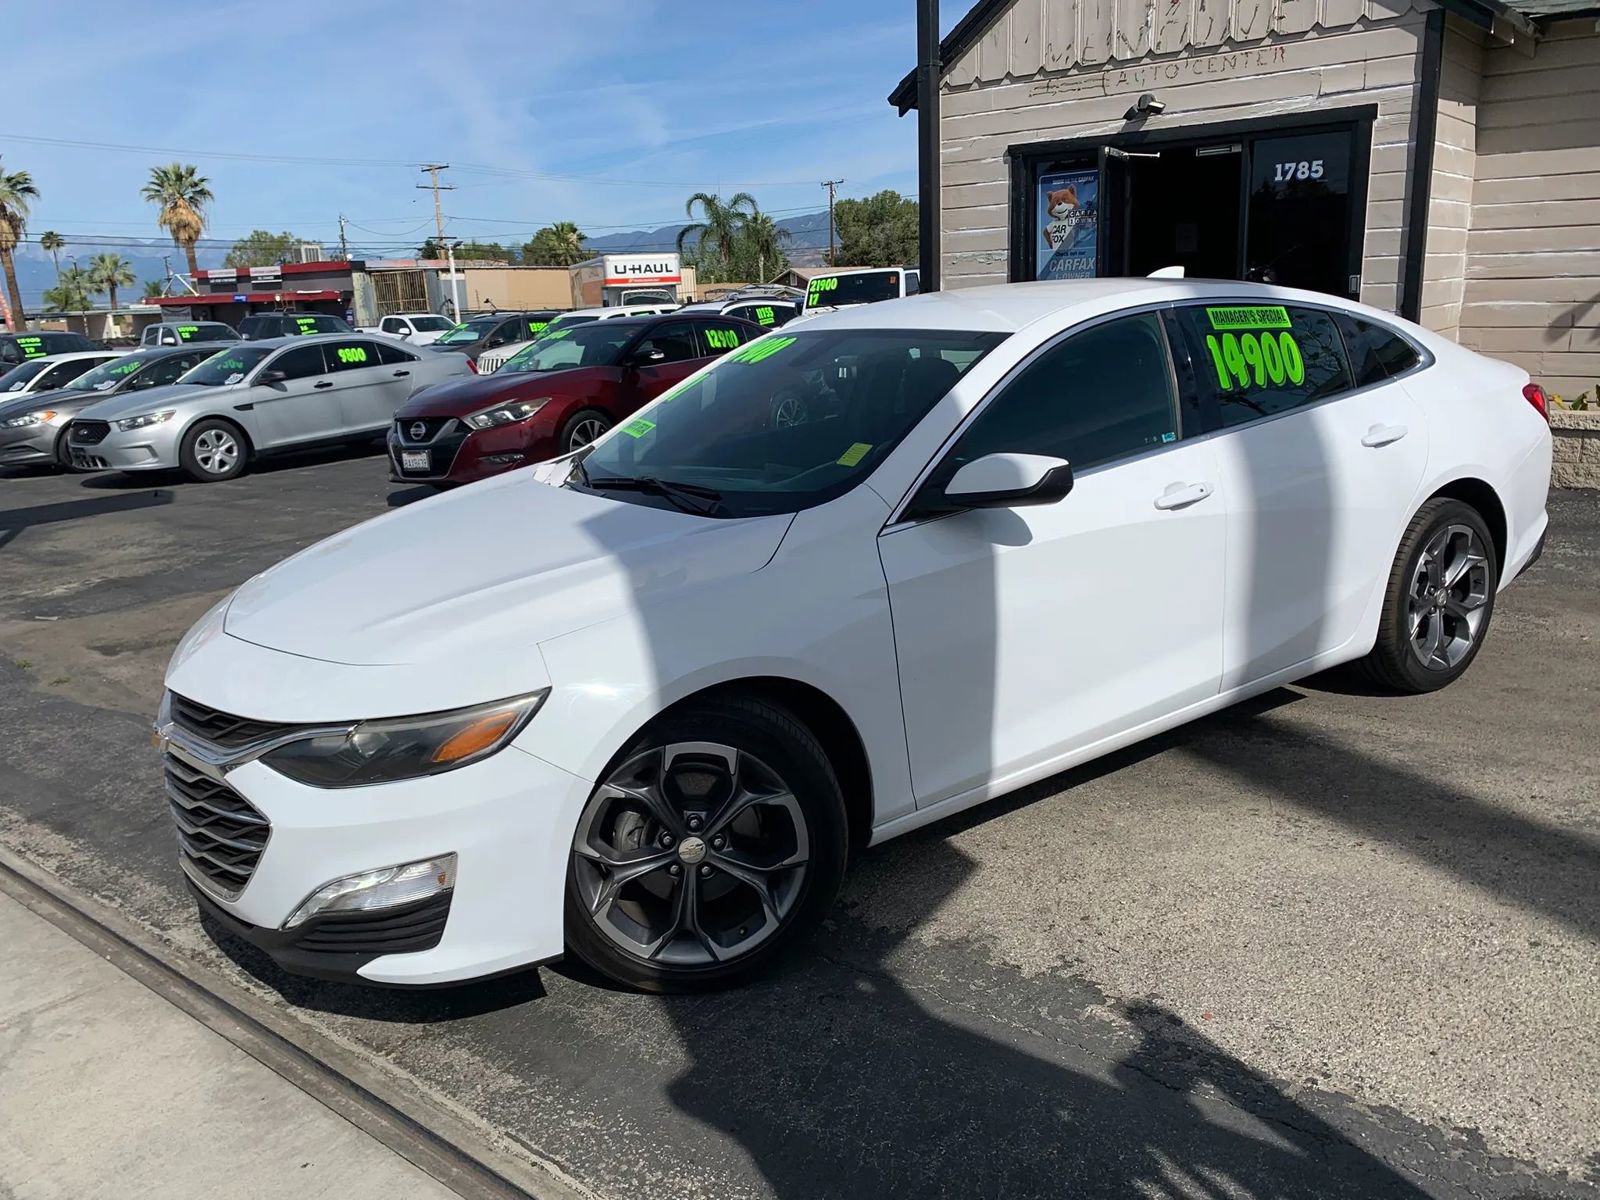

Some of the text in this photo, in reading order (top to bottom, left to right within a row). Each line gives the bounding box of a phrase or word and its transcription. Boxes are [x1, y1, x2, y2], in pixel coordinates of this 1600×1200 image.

[1116, 46, 1286, 87] AUTO CENTER
[1274, 160, 1324, 181] 1785
[1053, 225, 1066, 234] CAR
[614, 263, 673, 274] U-HAUL
[1049, 257, 1095, 272] CARFAX
[810, 278, 838, 292] 21900
[808, 293, 819, 306] 17
[1211, 308, 1287, 325] MANAGER'S SPECIAL
[705, 329, 739, 348] 12900
[337, 347, 367, 363] 9800
[1206, 331, 1305, 391] 14900
